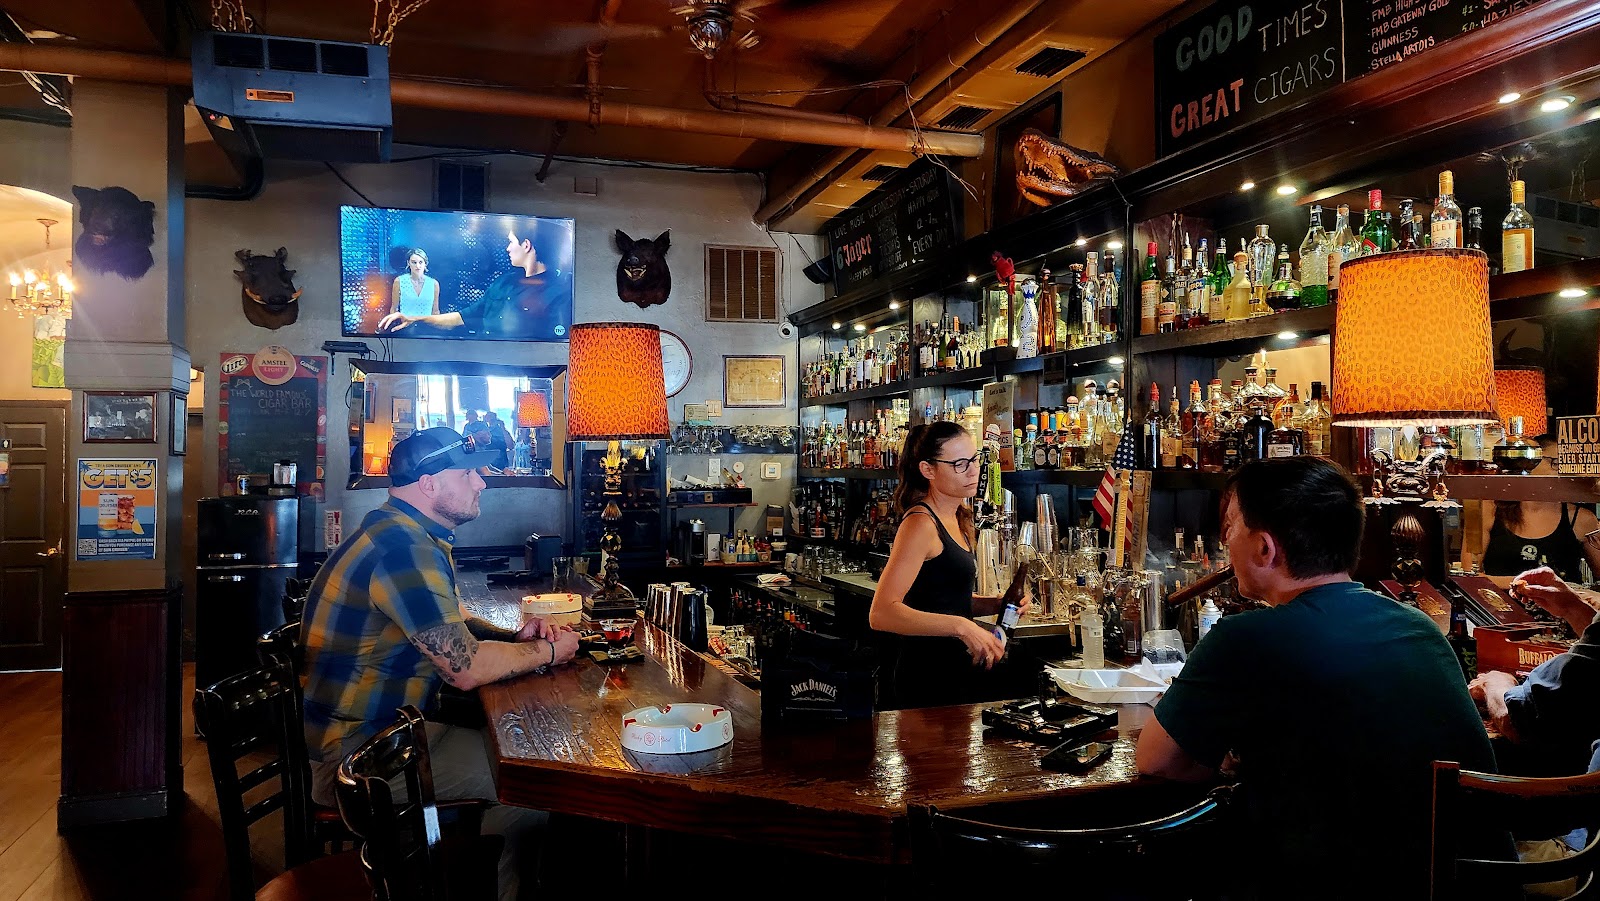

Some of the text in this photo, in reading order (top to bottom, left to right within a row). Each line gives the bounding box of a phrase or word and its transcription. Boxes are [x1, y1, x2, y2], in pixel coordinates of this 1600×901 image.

[1371, 4, 1392, 22] FMB
[1371, 21, 1390, 38] FMB
[1390, 3, 1427, 29] GATEWAY
[1176, 1, 1328, 70] GOOD TIMES
[1371, 26, 1419, 55] GUINNESS
[1370, 36, 1435, 70] STELLA ARTOIS
[1170, 47, 1336, 138] GREAT CIGARS
[834, 223, 848, 239] LIVE
[850, 214, 866, 230] MUSIC
[912, 235, 933, 256] EVERY
[300, 360, 320, 373] GUINNESS
[230, 389, 247, 398] THE
[250, 388, 274, 399] WORLD
[258, 398, 312, 409] CIGAR BAR
[1558, 418, 1600, 443] ALCO
[1558, 444, 1583, 453] BECAUSE
[1583, 444, 1592, 453] NO
[1558, 454, 1576, 463] EVER
[83, 469, 152, 489] GET $5
[1558, 464, 1585, 474] SOMEONE
[791, 679, 838, 698] JACK DANIEL'S
